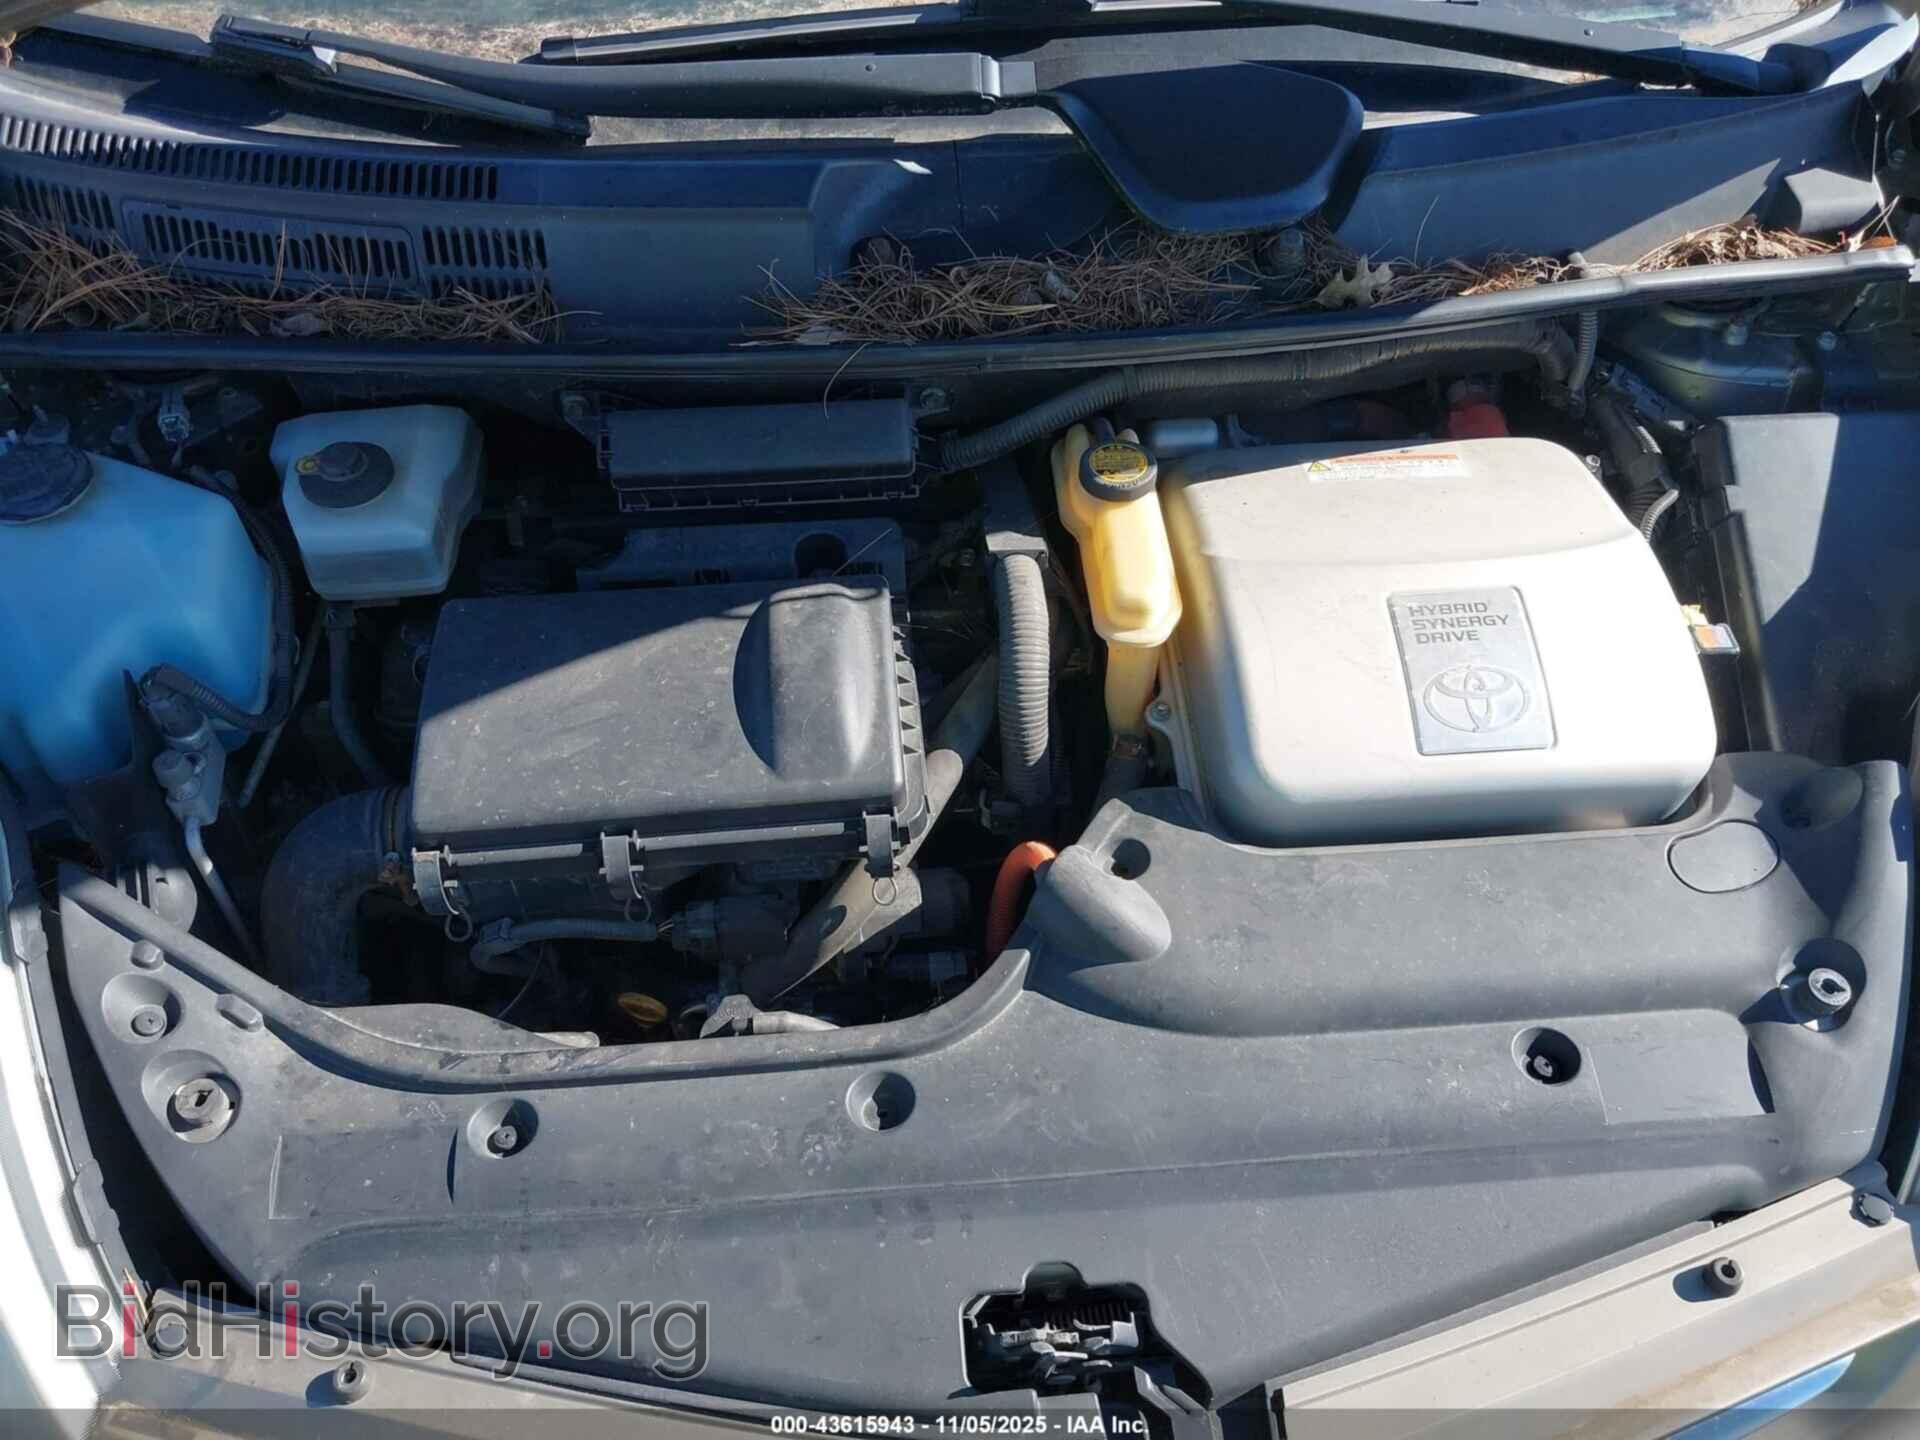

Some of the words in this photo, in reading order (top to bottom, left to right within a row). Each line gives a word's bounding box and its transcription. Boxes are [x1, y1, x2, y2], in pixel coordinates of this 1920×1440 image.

[1408, 602, 1488, 617] HYBRID
[1411, 614, 1509, 631] SYNERGY
[1415, 630, 1481, 645] DRIVE
